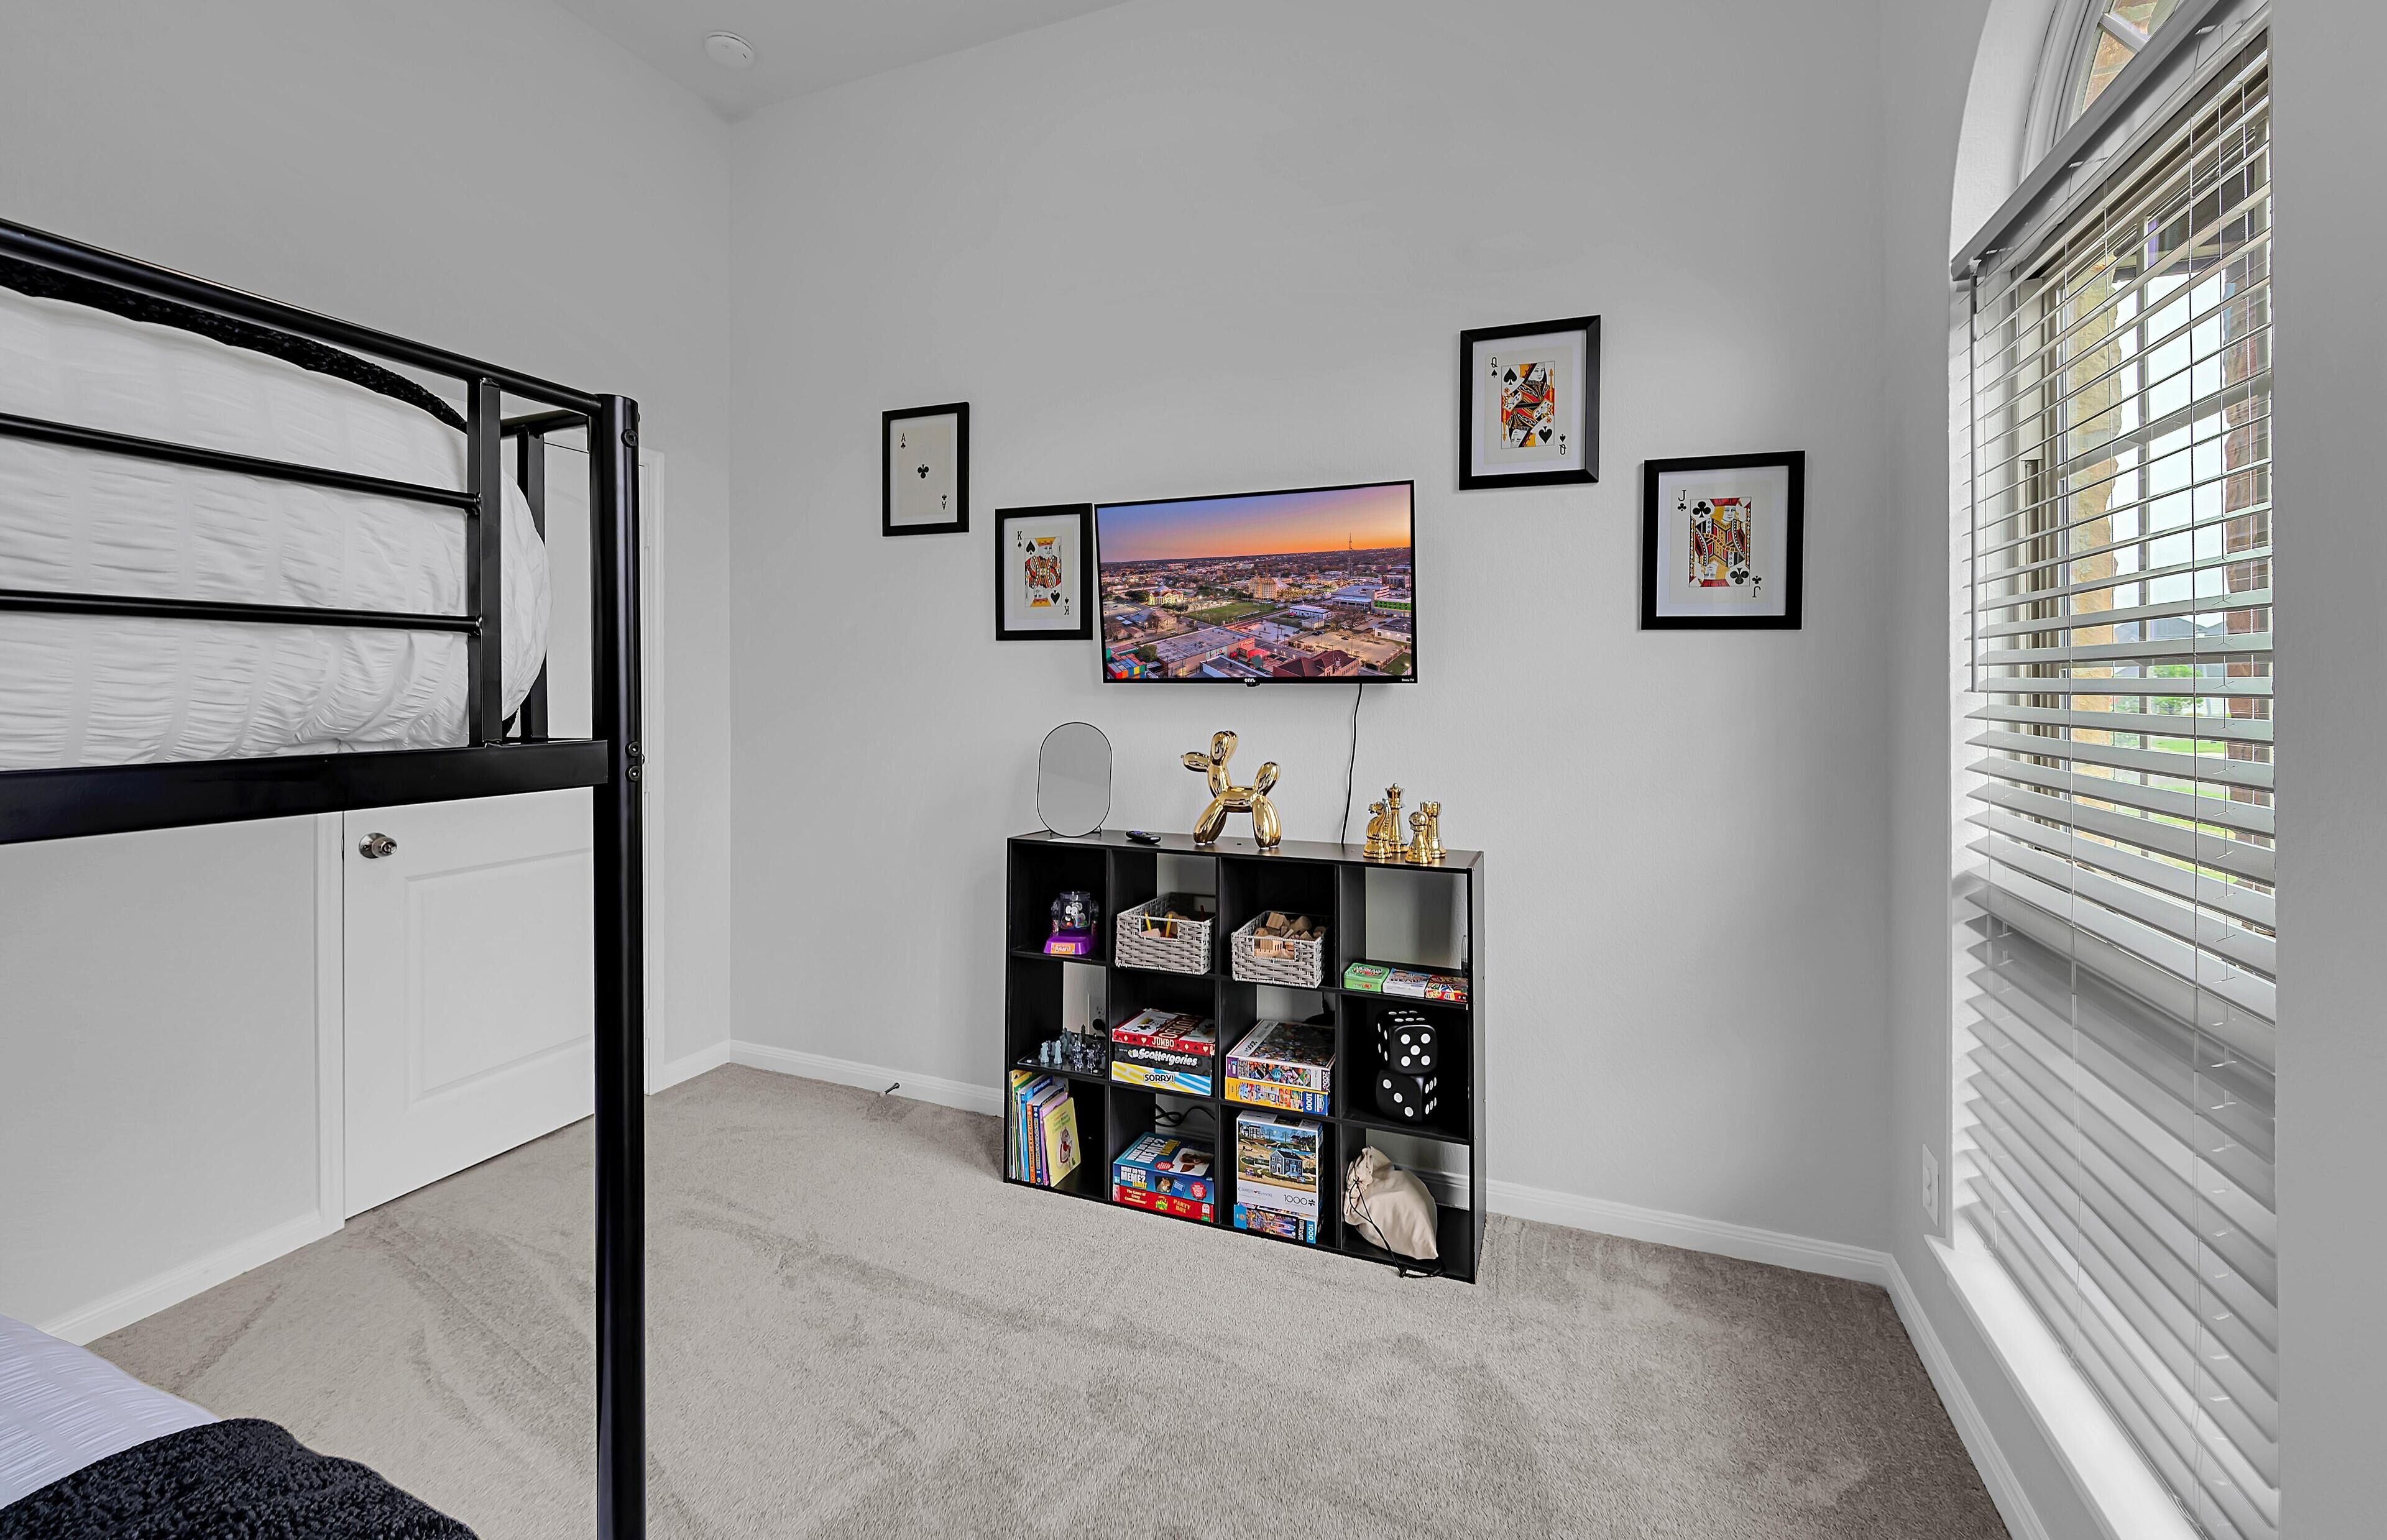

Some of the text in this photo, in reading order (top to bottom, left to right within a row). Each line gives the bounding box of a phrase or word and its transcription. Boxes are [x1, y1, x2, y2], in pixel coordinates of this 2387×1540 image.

[1491, 357, 1498, 368] Q
[901, 433, 906, 442] A
[1559, 444, 1566, 455] Q
[1678, 490, 1687, 502] J
[941, 501, 947, 510] A
[1017, 531, 1023, 540] K
[1752, 585, 1761, 598] J
[1064, 606, 1069, 615] K
[1152, 1037, 1174, 1048] JUMBO
[1138, 1048, 1198, 1066] Scattergories
[1144, 1073, 1174, 1083] SORRY!
[1121, 1171, 1146, 1183] MEME?
[1173, 1198, 1191, 1211] PARTY
[1284, 1194, 1308, 1206] 1000
[1175, 1205, 1186, 1214] BOX
